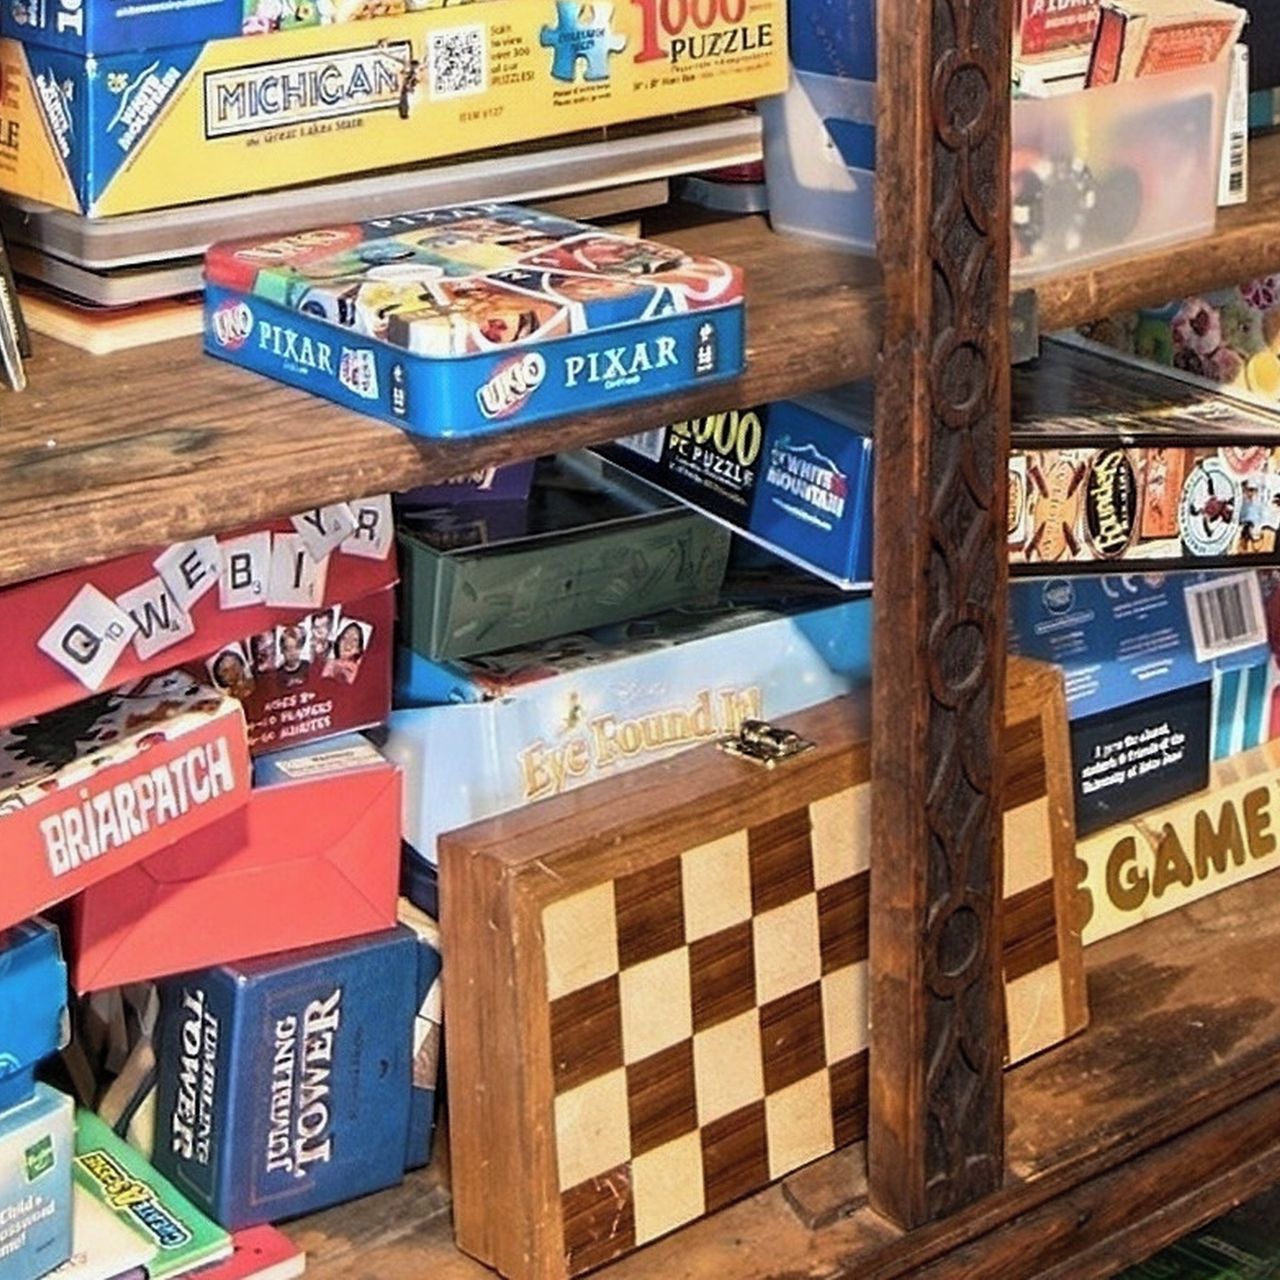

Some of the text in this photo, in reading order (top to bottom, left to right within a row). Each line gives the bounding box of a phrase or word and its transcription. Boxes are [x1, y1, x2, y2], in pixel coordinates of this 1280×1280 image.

[670, 22, 774, 63] PUZZLE
[117, 66, 182, 151] MOUNTAIN
[217, 60, 401, 121] MICHIGAN
[214, 301, 254, 345] UNO
[257, 321, 335, 376] PIXAR
[479, 352, 547, 419] UNO
[564, 336, 679, 388] PIXAR
[691, 446, 755, 488] PUZZLE
[766, 469, 846, 519] MOUNTAIN
[787, 455, 832, 489] WHITE
[1090, 450, 1129, 552] Founders
[279, 715, 333, 740] MINUTES
[280, 700, 333, 723] PLAYERS
[519, 738, 592, 799] Eye
[593, 687, 714, 767] Found
[1104, 785, 1278, 913] GAME
[172, 988, 207, 1160] TOWER
[197, 1011, 219, 1165] JUMBLING
[266, 1015, 298, 1174] JUMBLING
[292, 987, 342, 1178] TOWER
